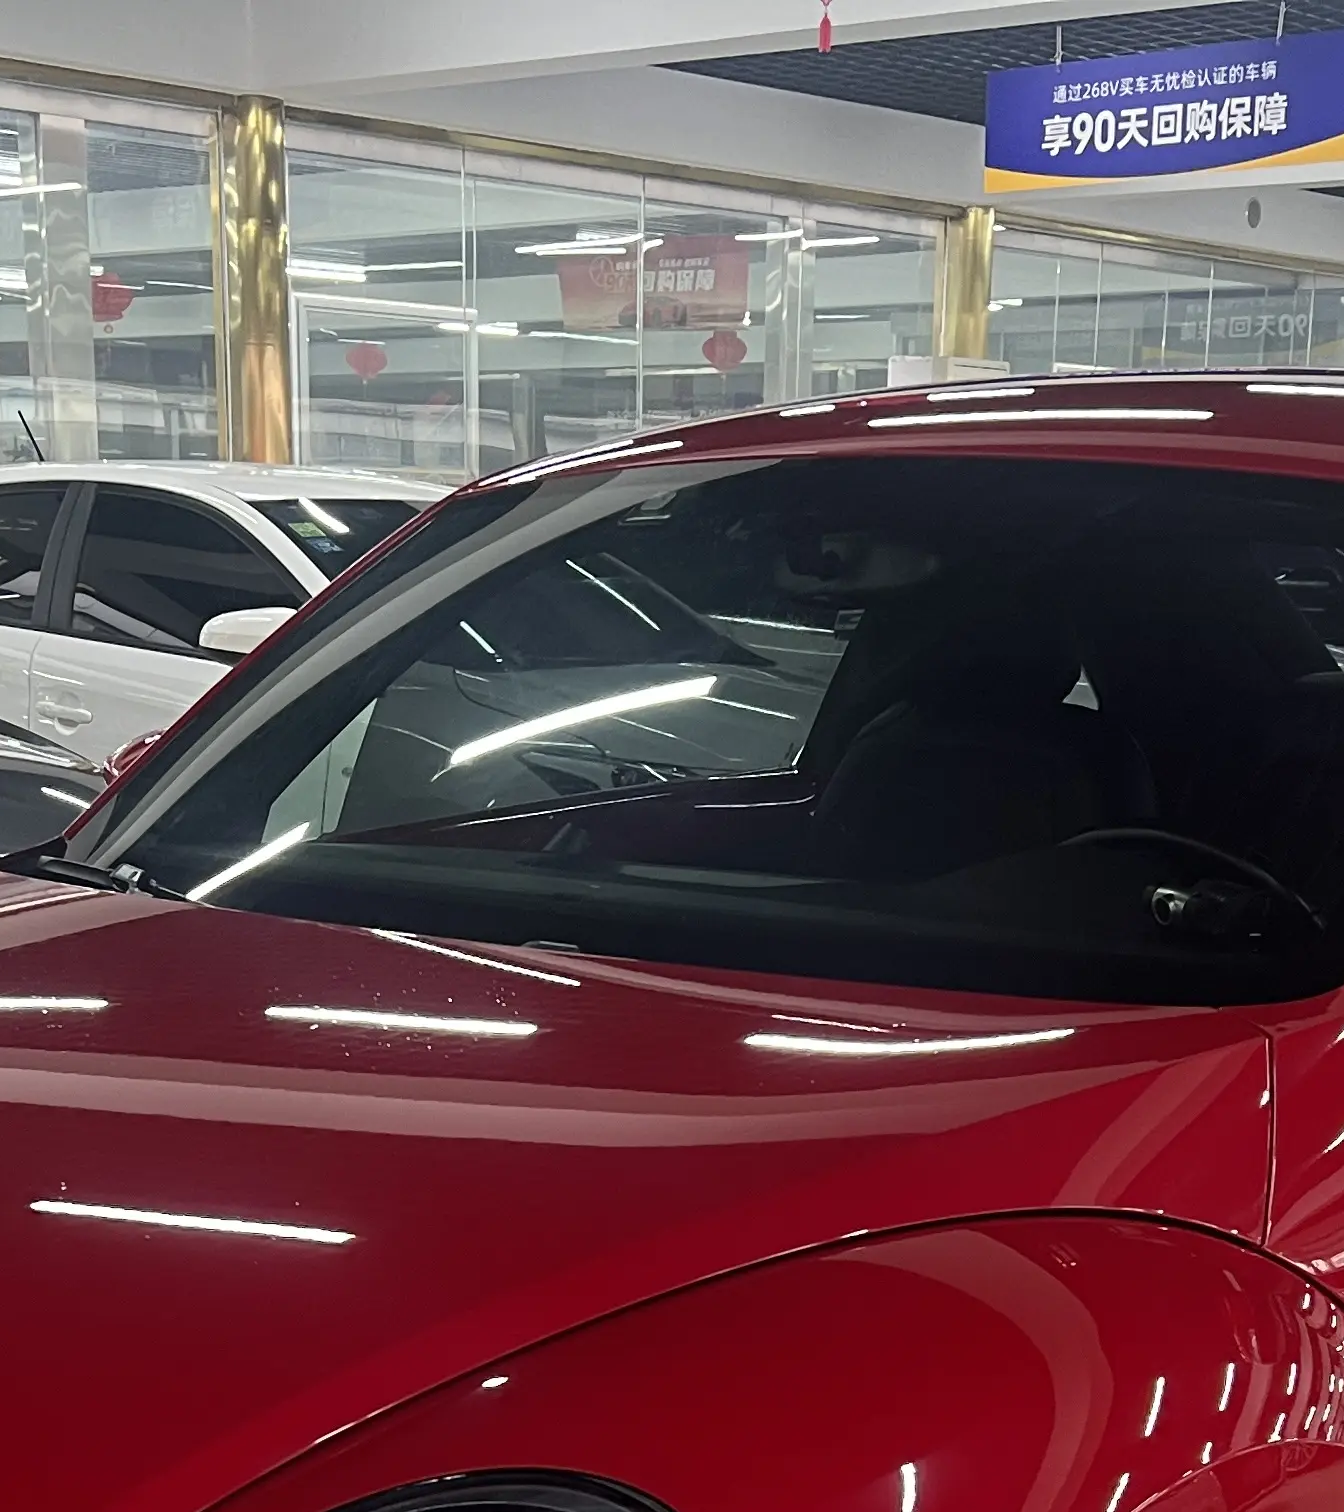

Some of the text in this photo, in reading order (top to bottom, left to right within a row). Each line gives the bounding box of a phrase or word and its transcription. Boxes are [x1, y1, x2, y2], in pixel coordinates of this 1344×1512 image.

[1053, 59, 1277, 104] 通过268V买车无忧检认证的车辆
[1041, 91, 1288, 157] 享90天回购保障
